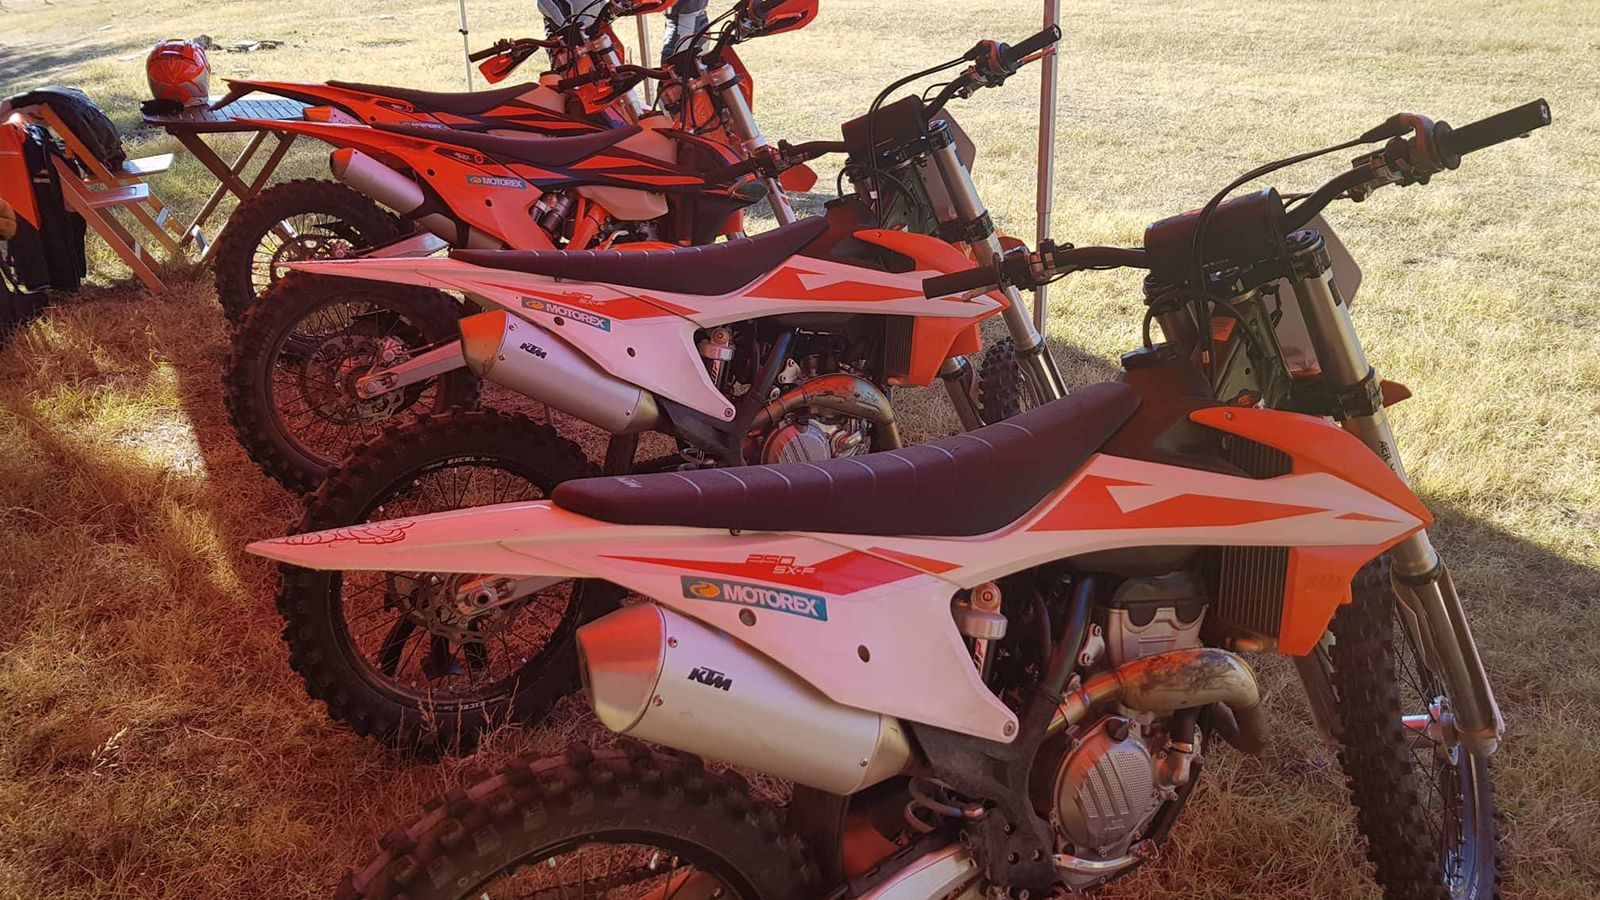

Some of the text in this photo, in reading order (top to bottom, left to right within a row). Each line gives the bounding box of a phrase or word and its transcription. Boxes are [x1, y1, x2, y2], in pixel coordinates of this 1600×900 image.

[482, 176, 524, 188] MOTOREX
[546, 303, 606, 328] MOTOREX
[520, 342, 547, 359] KTM
[746, 554, 796, 566] 250
[772, 565, 816, 575] SX-F
[722, 583, 819, 616] MOTOREX
[687, 666, 733, 691] KTM
